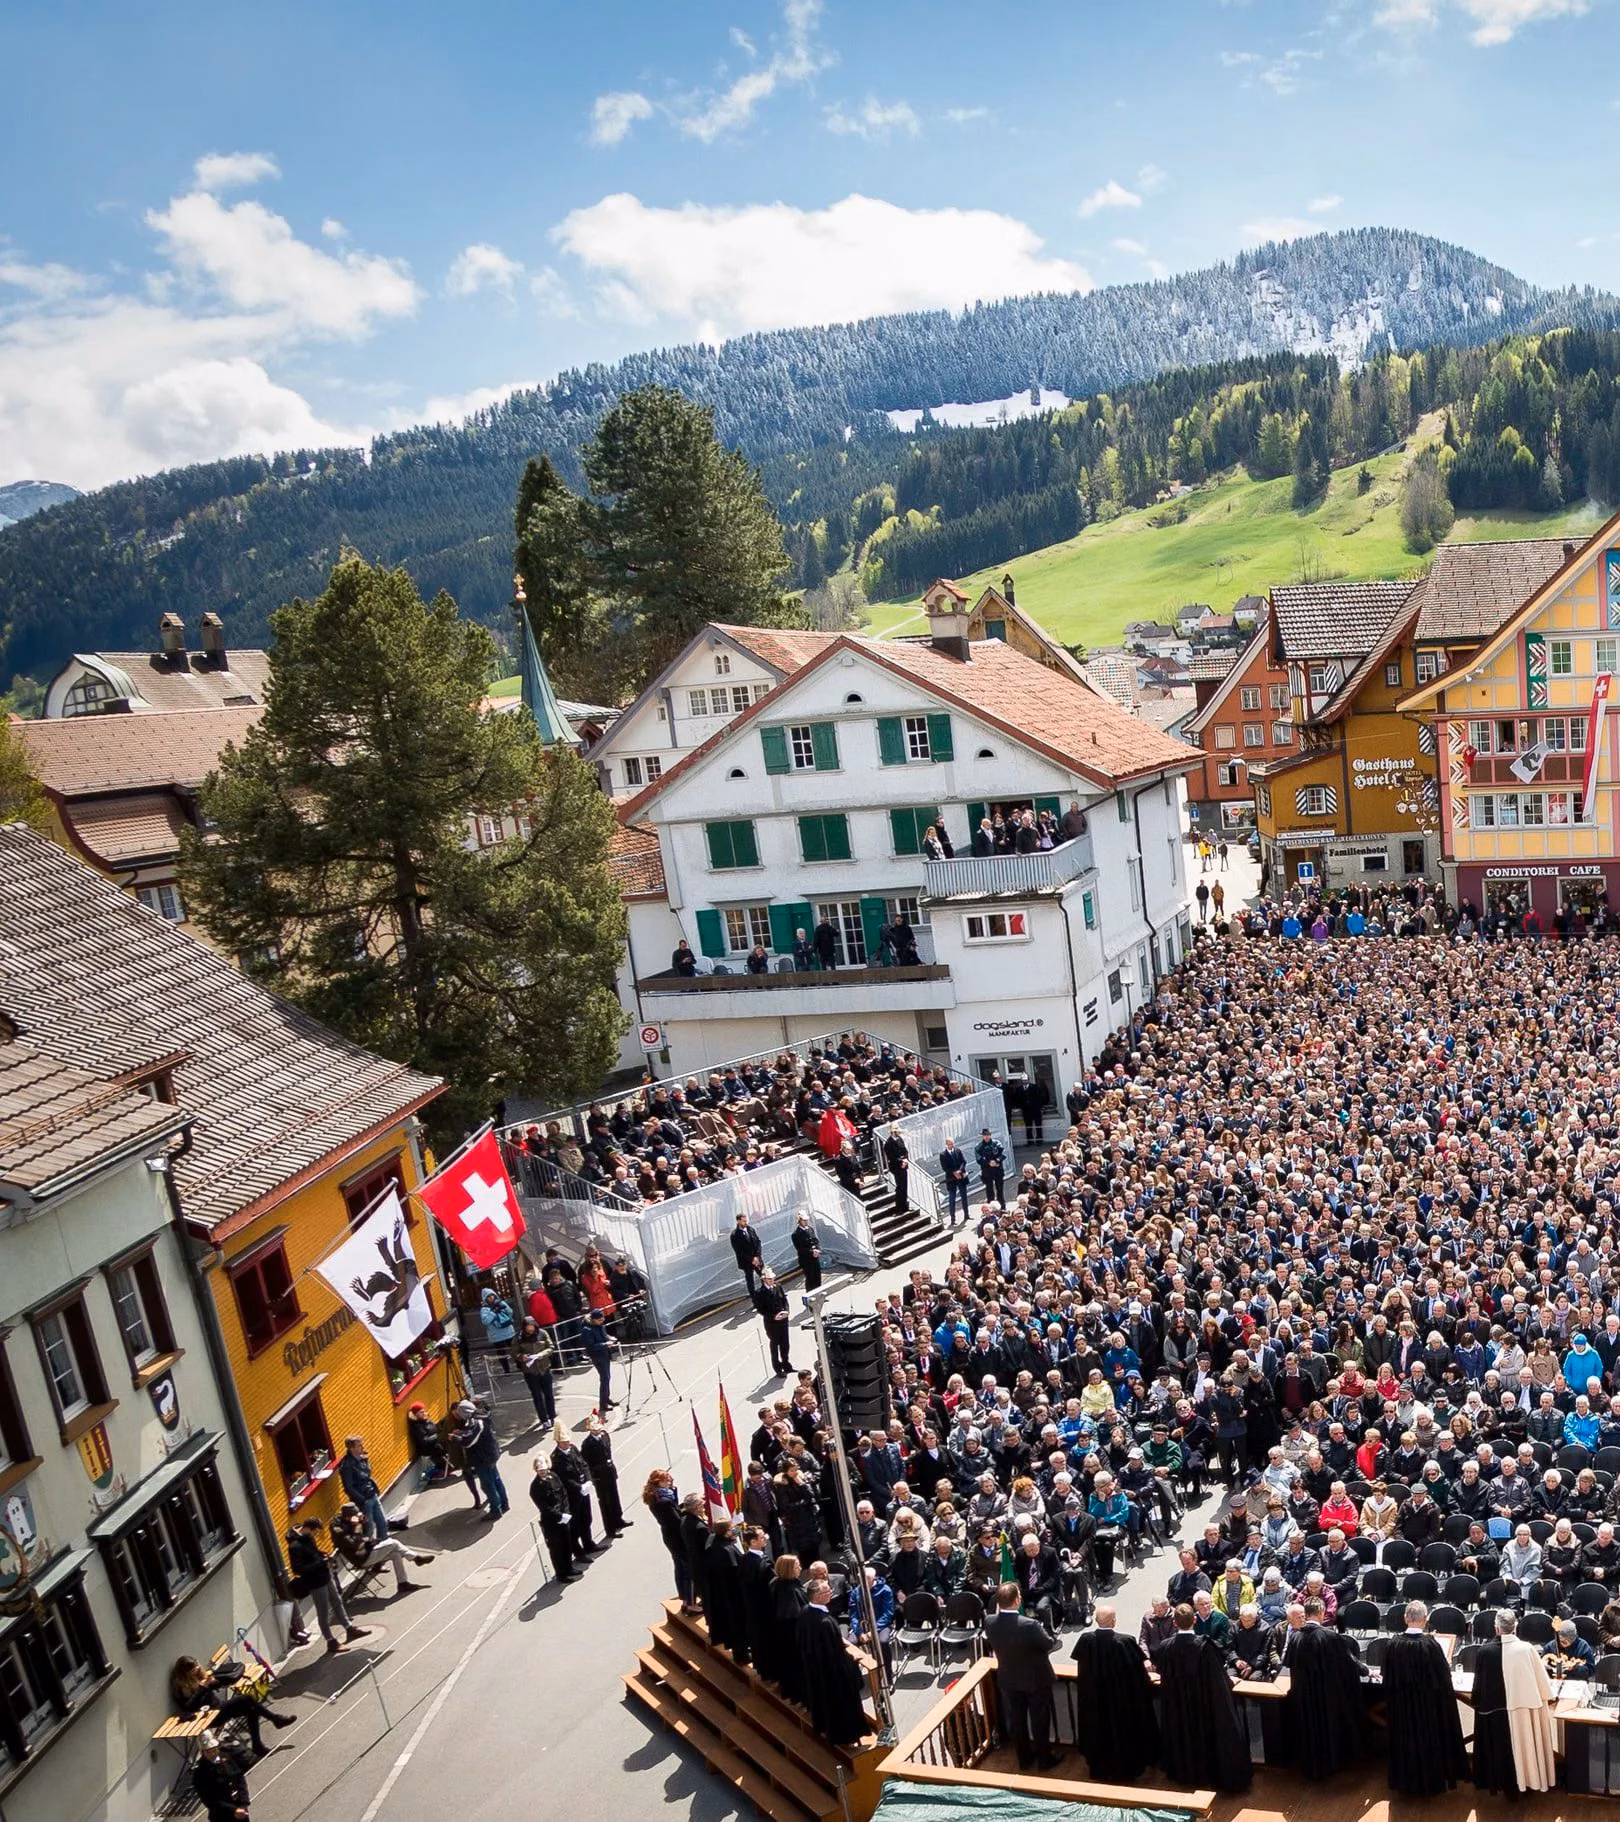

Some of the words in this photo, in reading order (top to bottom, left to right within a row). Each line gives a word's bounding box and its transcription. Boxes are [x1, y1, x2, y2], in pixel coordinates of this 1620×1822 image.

[1352, 757, 1415, 773] Gasthaus
[1353, 772, 1389, 790] Hotel
[1328, 845, 1388, 857] Familienhotel
[1486, 866, 1560, 877] CONDITOREI
[1569, 865, 1601, 876] CAFE
[988, 1029, 1031, 1037] MANUFAKTUR
